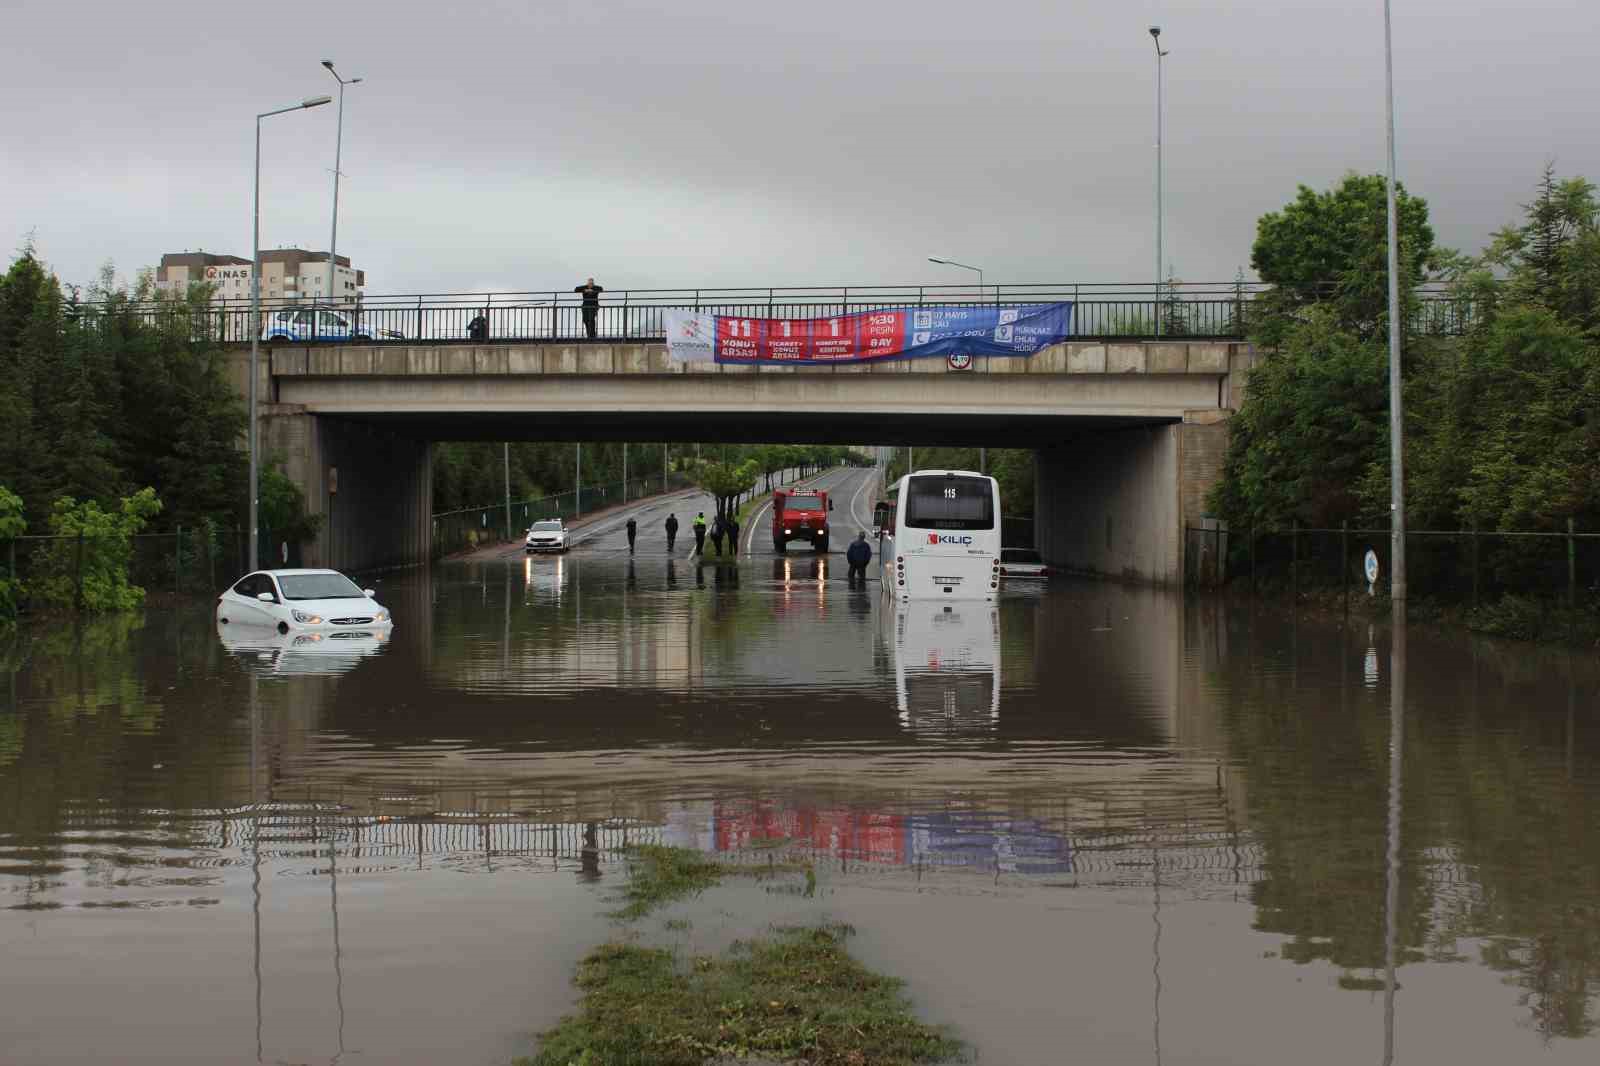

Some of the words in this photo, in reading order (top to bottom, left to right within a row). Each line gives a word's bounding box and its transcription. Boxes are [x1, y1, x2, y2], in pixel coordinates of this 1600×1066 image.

[728, 319, 751, 337] 11
[780, 319, 791, 337] 1
[829, 318, 839, 337] 1
[721, 339, 756, 348] KONUT
[721, 347, 757, 357] ARSASI
[944, 487, 956, 499] 115
[938, 535, 973, 547] KILIÇ
